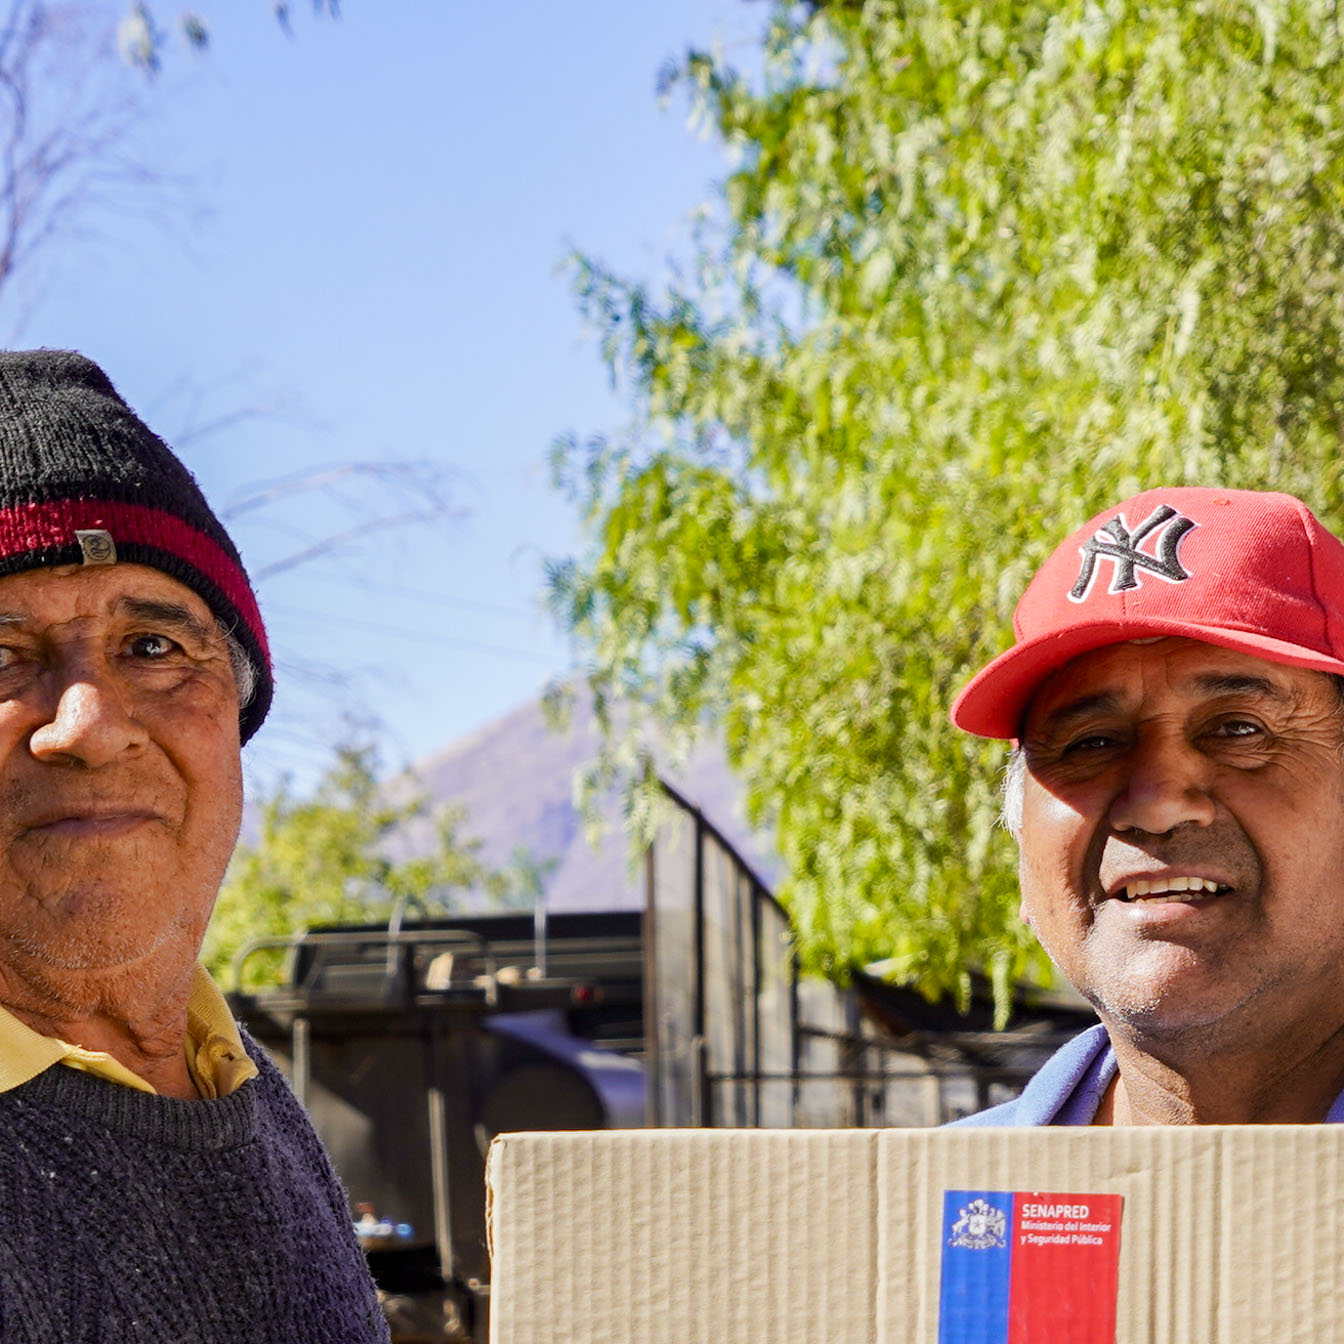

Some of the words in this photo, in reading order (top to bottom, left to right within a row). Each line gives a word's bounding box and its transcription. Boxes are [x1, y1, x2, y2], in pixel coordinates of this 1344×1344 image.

[1021, 1203, 1089, 1219] SENAPRED
[1021, 1220, 1064, 1231] Ministerio
[1064, 1221, 1079, 1231] del
[1079, 1221, 1112, 1232] Interior
[1020, 1235, 1027, 1246] y
[1027, 1233, 1071, 1247] Seguridad
[1071, 1234, 1103, 1245] Pública
